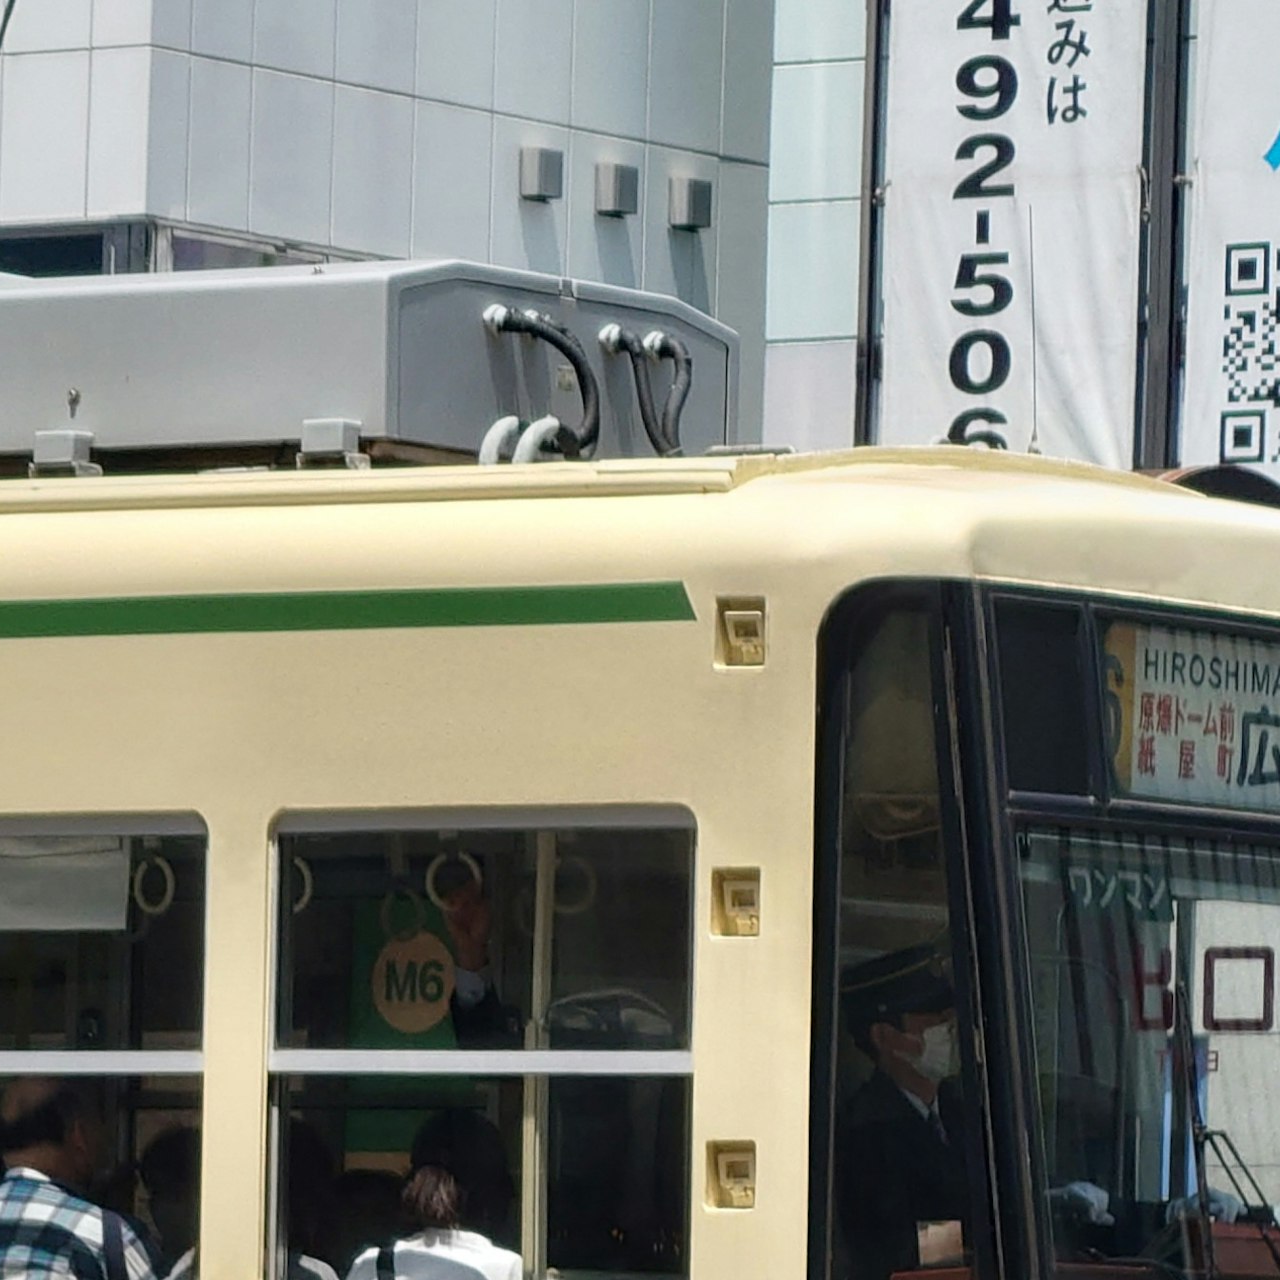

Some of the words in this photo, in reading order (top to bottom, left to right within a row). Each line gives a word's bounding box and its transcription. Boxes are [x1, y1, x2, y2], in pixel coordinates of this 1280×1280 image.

[1139, 692, 1236, 743] 原爆ドーム前
[1067, 866, 1168, 911] ワンマン
[384, 959, 445, 1004] M6
